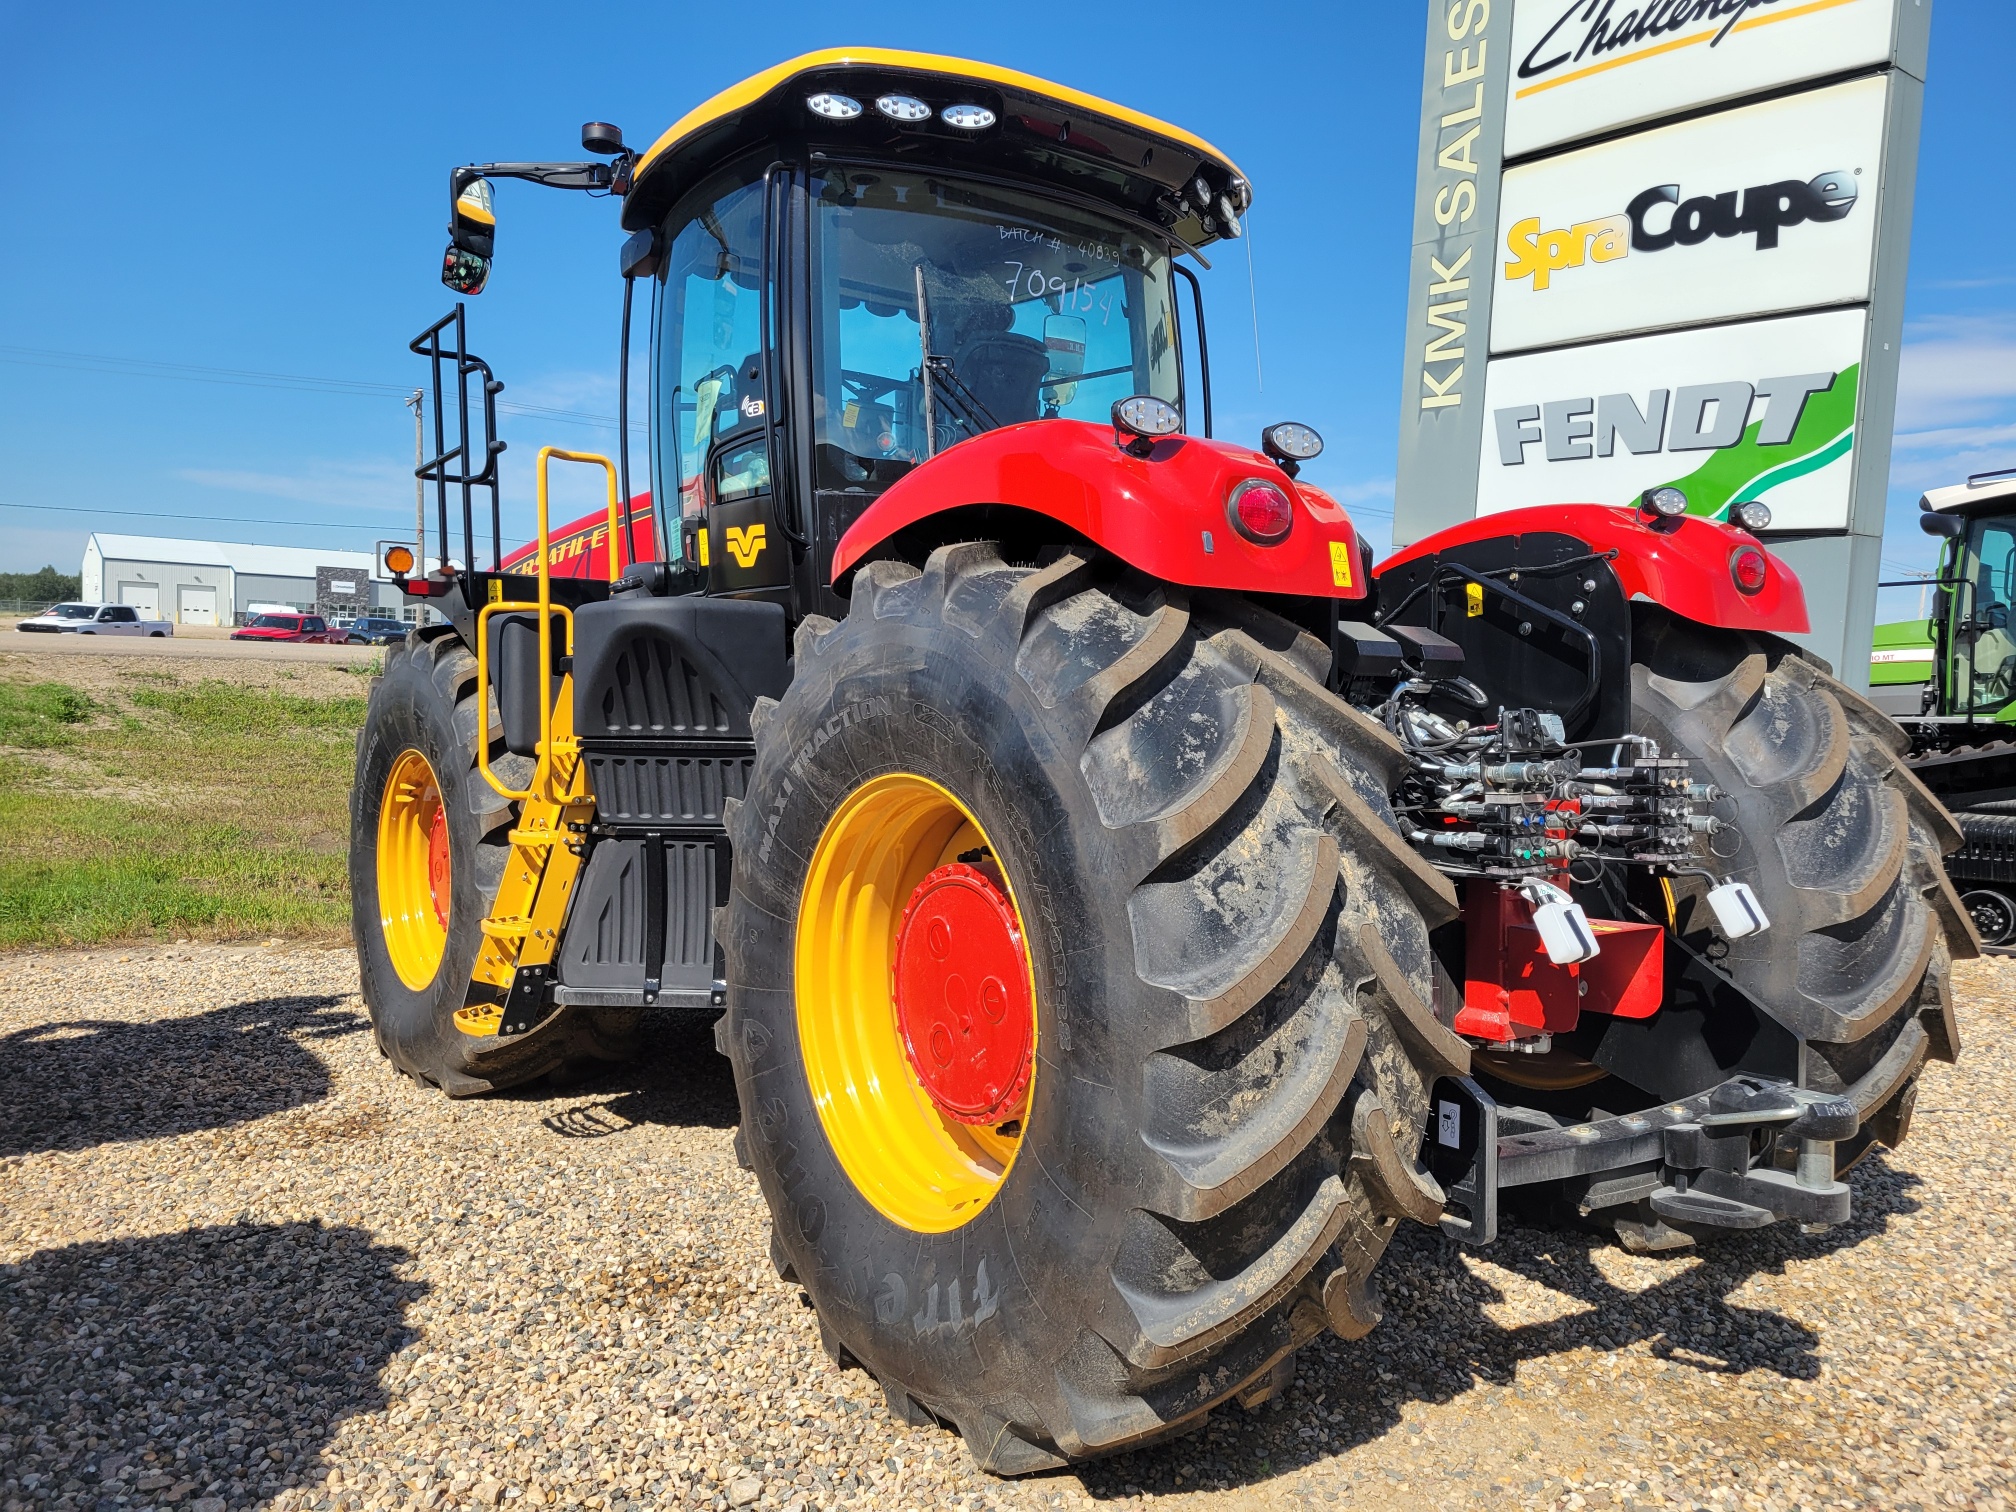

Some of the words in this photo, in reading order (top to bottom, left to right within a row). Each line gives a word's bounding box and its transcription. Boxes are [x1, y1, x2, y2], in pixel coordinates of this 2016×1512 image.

[1434, 0, 1491, 226] SALES
[996, 225, 1044, 245] BATCH
[1078, 240, 1120, 268] 40839
[1004, 261, 1113, 326] 709154
[1421, 244, 1472, 409] KMK
[1492, 371, 1838, 467] FENDT
[758, 776, 794, 864] MAXI
[790, 695, 892, 776] TRACTION
